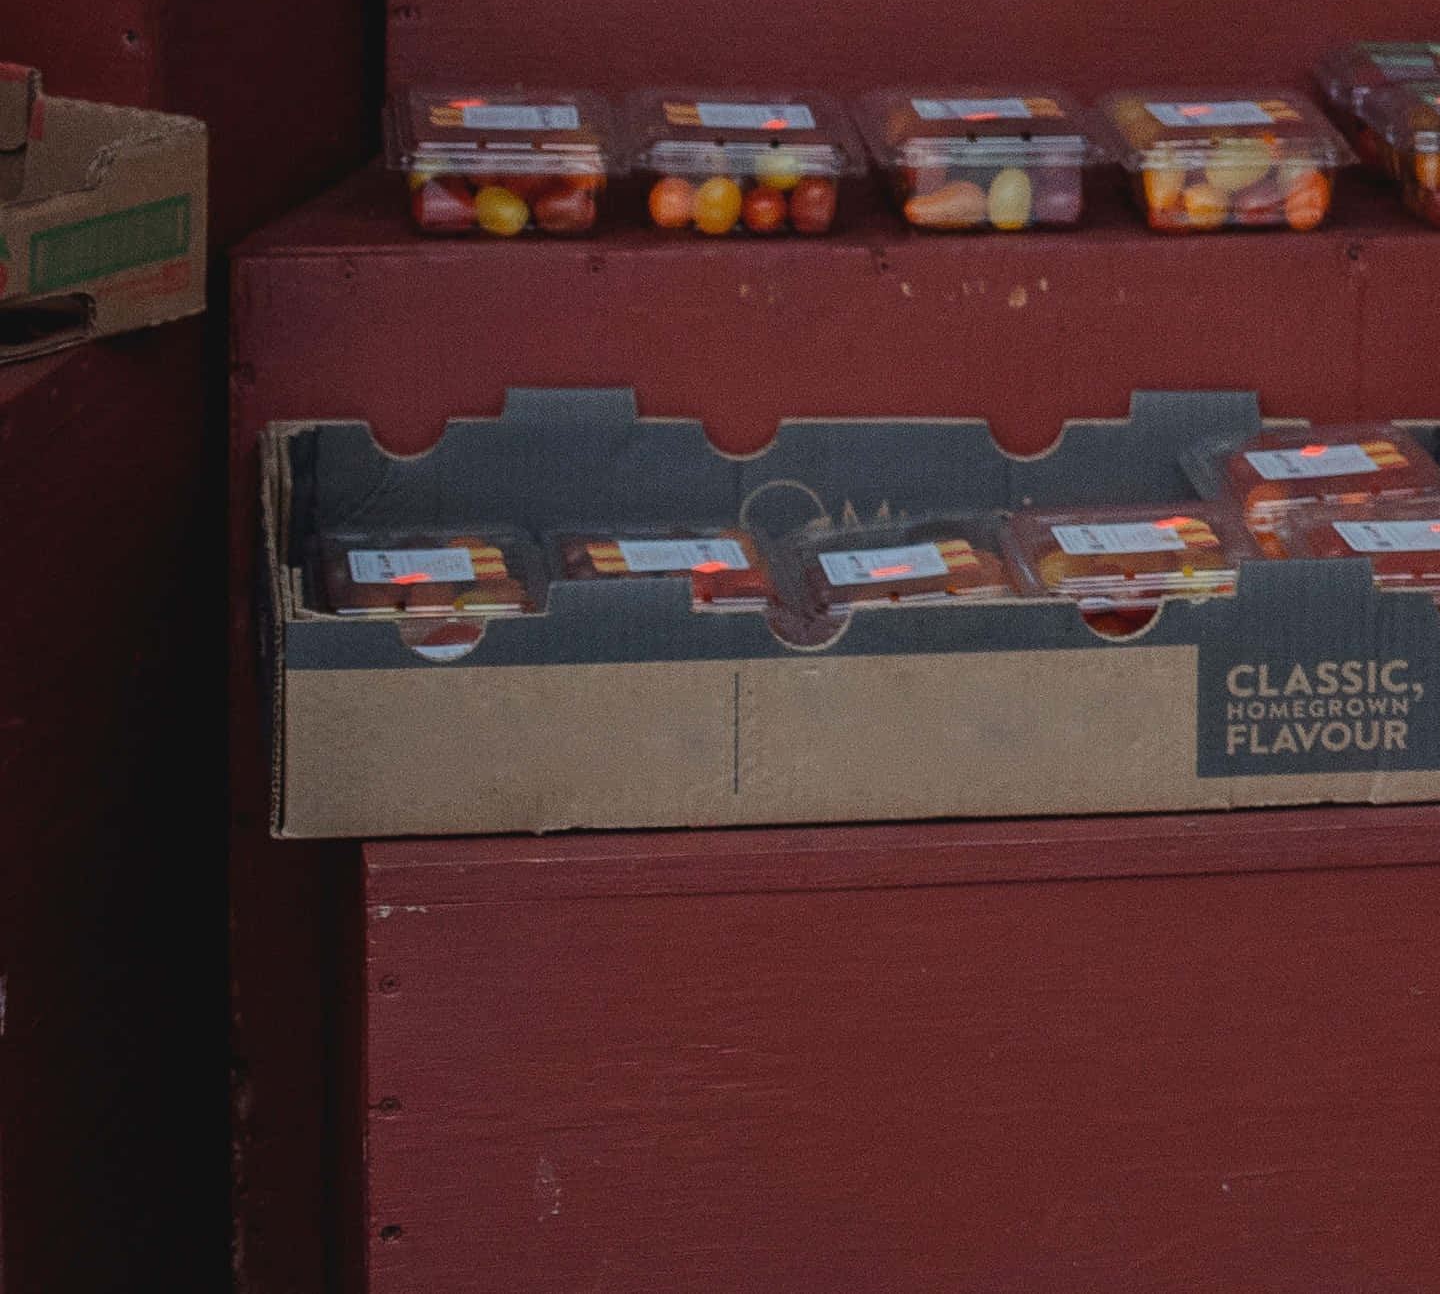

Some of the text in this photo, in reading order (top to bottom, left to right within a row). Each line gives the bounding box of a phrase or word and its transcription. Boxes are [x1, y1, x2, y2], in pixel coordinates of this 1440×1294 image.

[1225, 658, 1425, 701] CLASSIC,
[1226, 697, 1410, 721] HOMEGROWN
[1225, 719, 1409, 756] FLAVOUR
